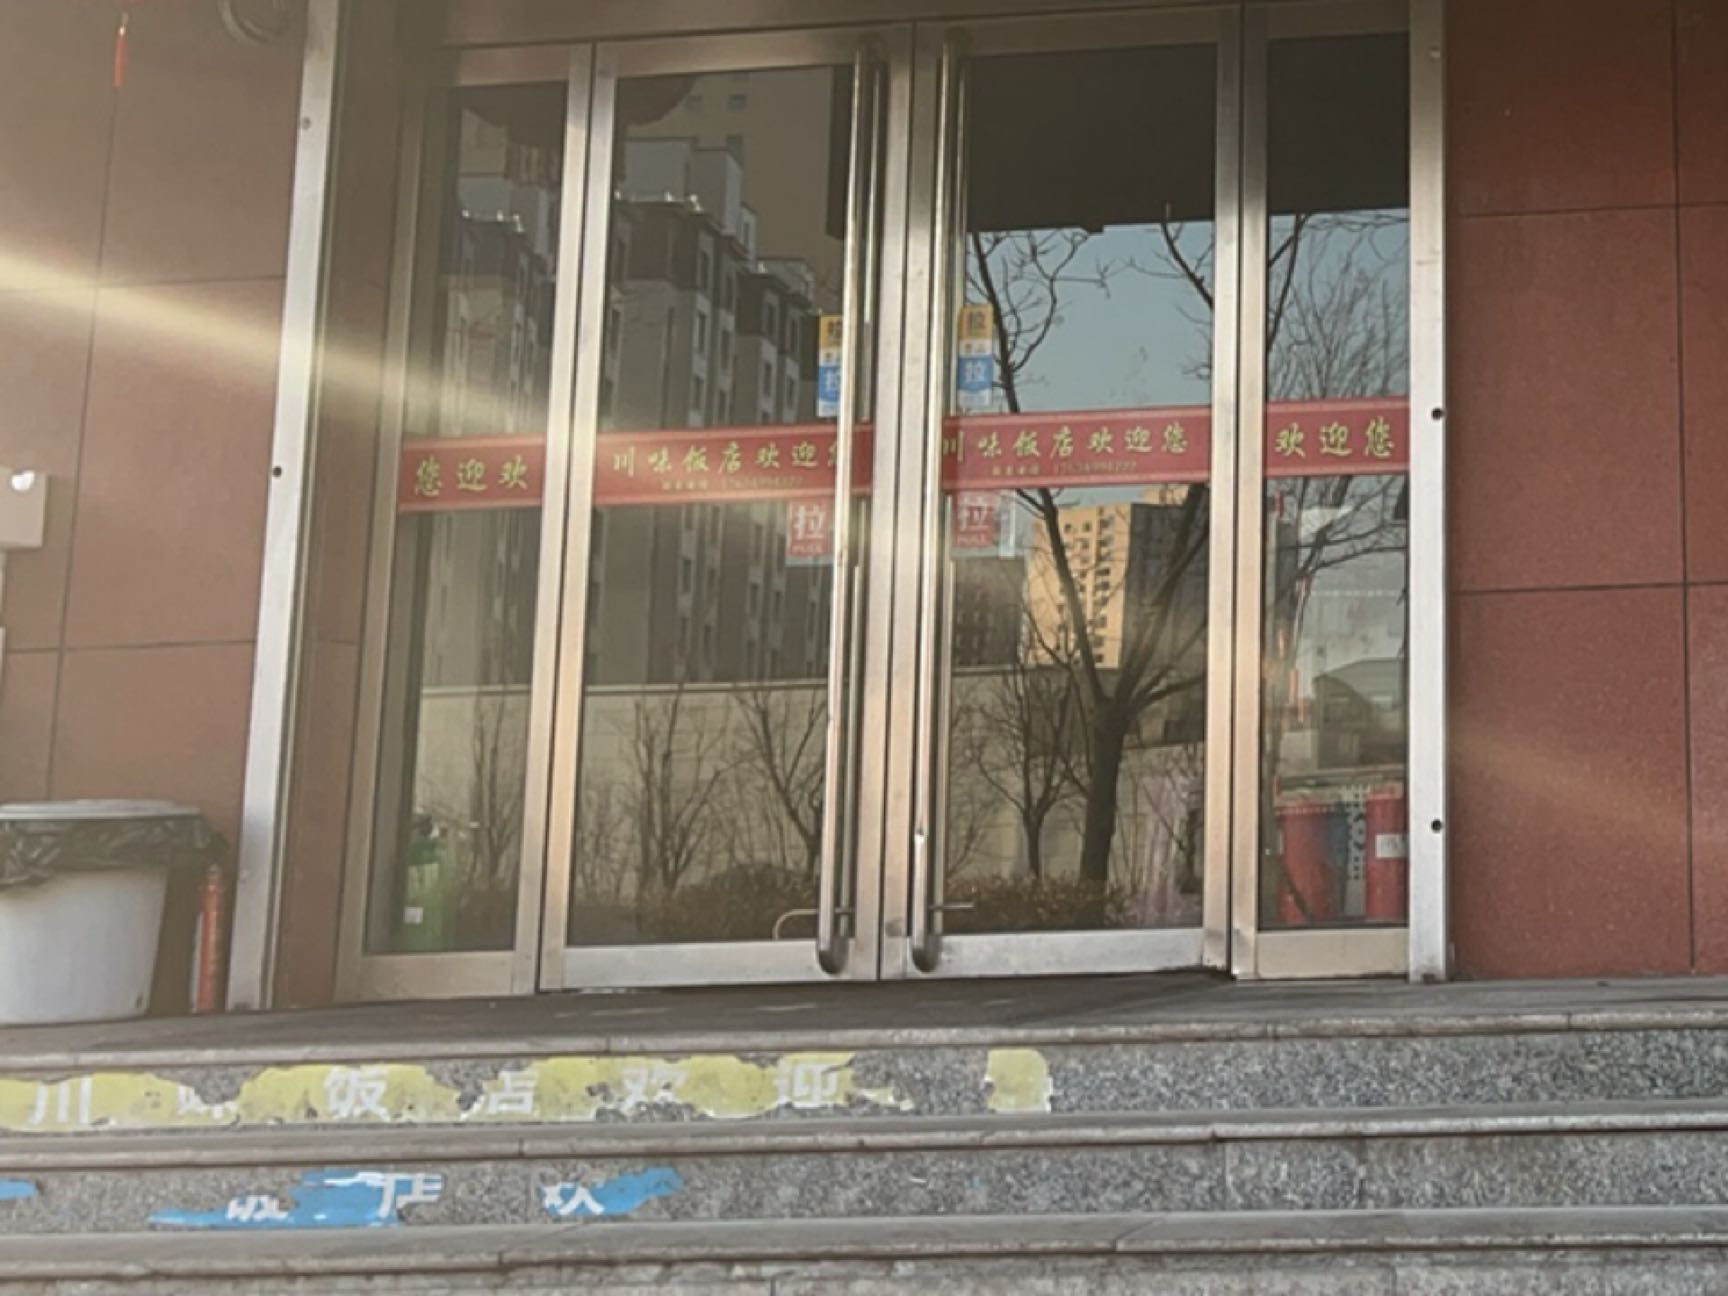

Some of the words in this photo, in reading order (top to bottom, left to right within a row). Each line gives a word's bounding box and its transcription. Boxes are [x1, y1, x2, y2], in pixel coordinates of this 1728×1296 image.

[942, 421, 1188, 463] 川味饭店欢迎您
[1274, 415, 1395, 459] 欢迎您
